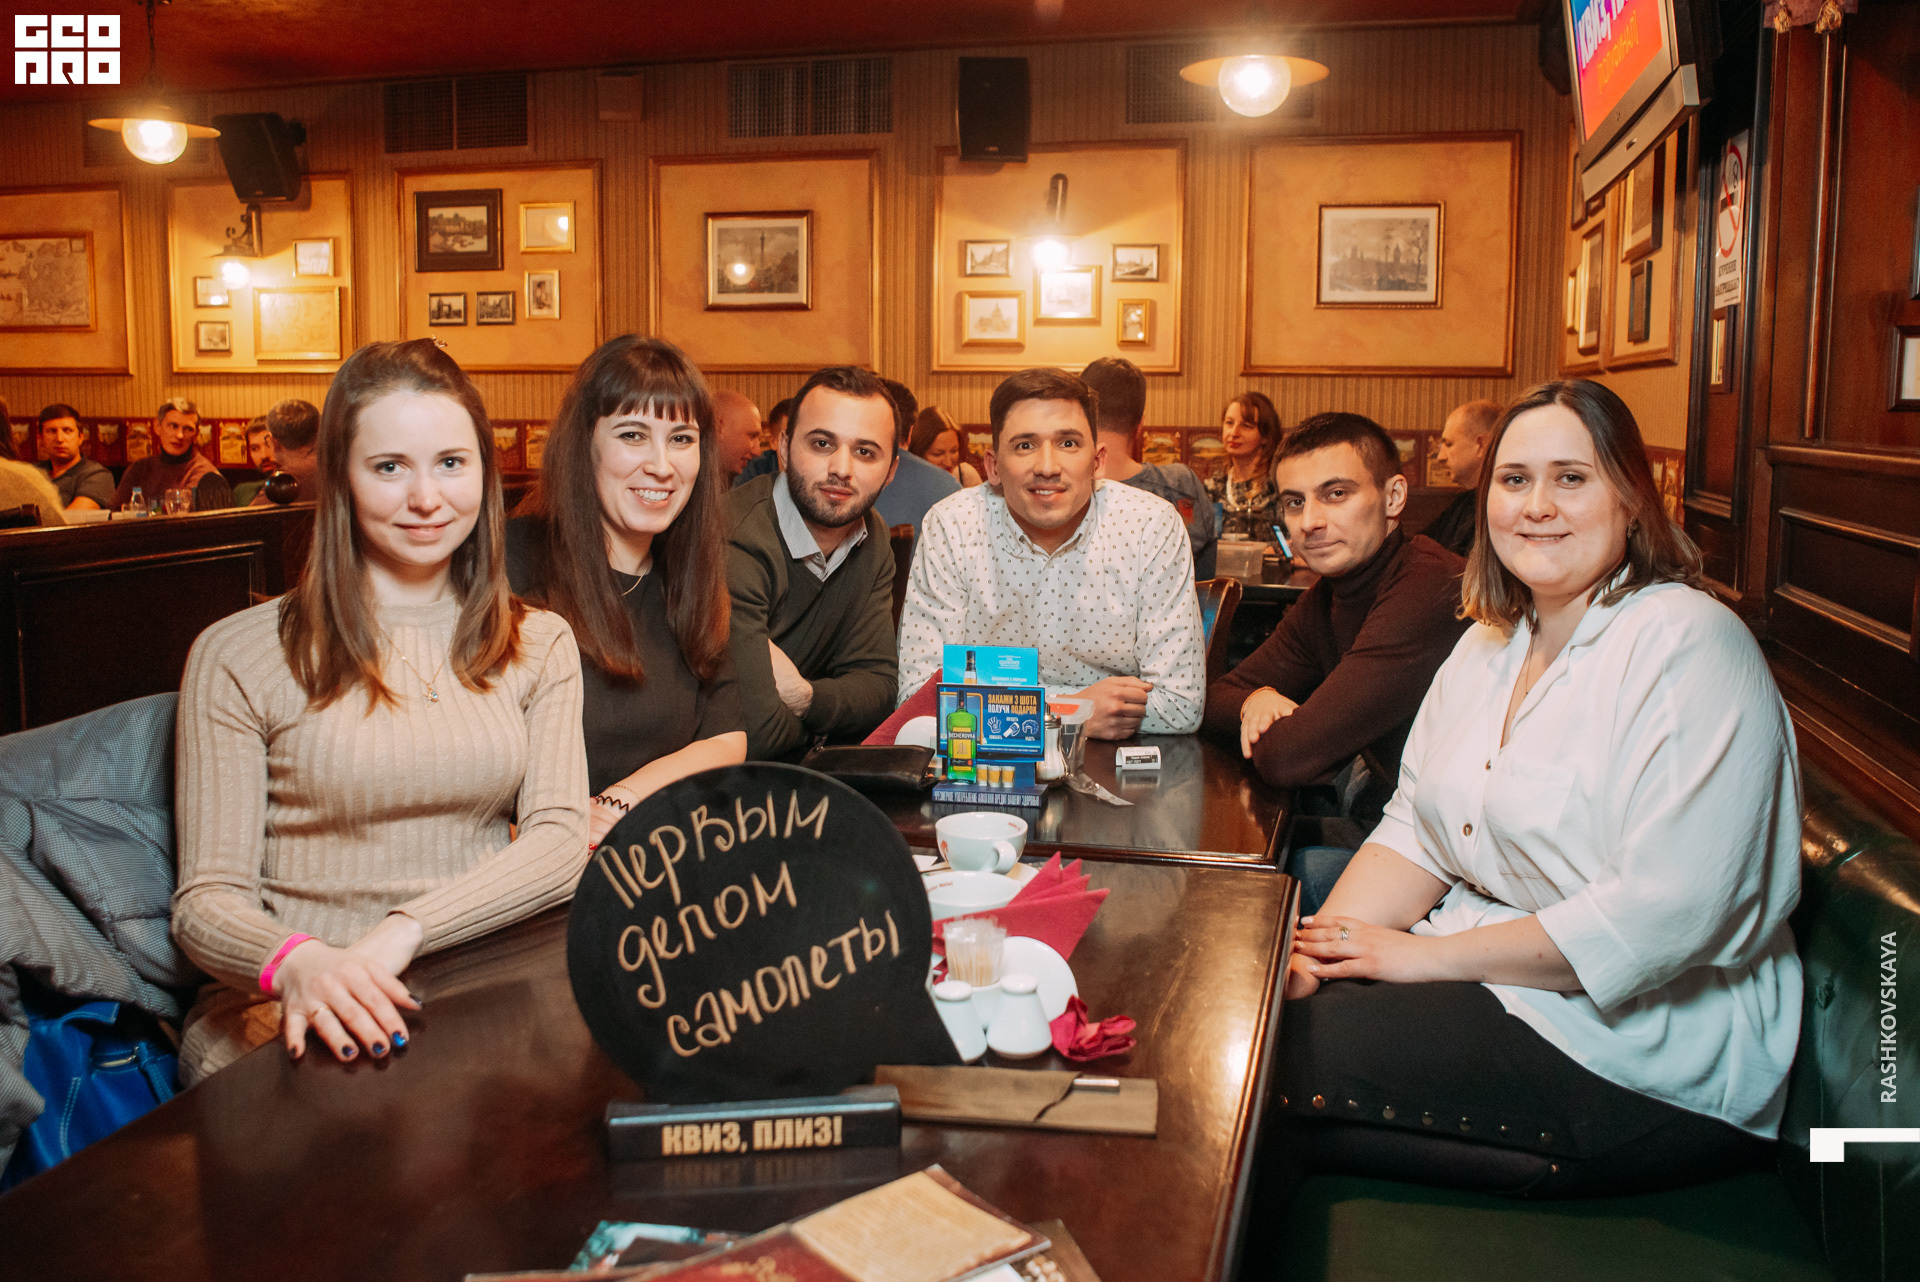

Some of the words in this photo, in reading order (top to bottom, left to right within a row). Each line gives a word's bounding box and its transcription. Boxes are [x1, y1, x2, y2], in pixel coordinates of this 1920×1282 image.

[988, 694, 1013, 705] ЗАКАЖИ
[1020, 696, 1037, 706] ШОТА
[988, 704, 1009, 713] ПОЛУЧИ
[1011, 705, 1037, 716] ПОДАРОК
[661, 1121, 748, 1156] КВИЗ,
[753, 1115, 843, 1149] ПЛИЗ!
